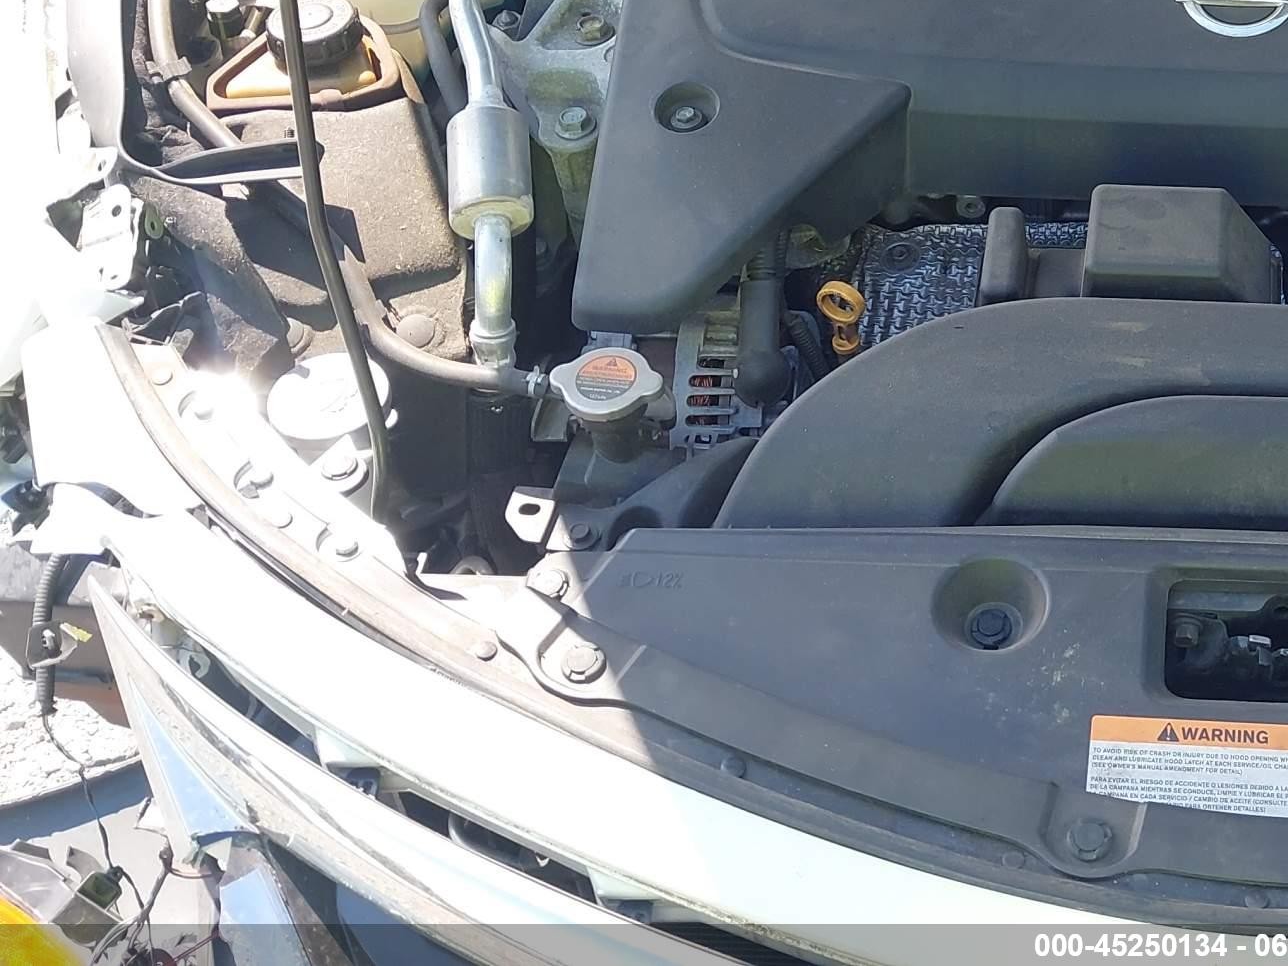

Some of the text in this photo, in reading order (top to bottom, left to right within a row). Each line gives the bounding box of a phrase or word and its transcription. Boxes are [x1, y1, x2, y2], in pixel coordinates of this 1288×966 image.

[1181, 727, 1269, 744] WARNING
[1128, 755, 1162, 763] LUBRICATE
[1137, 763, 1162, 771] MANUAL
[1163, 765, 1203, 773] AMENDMENT
